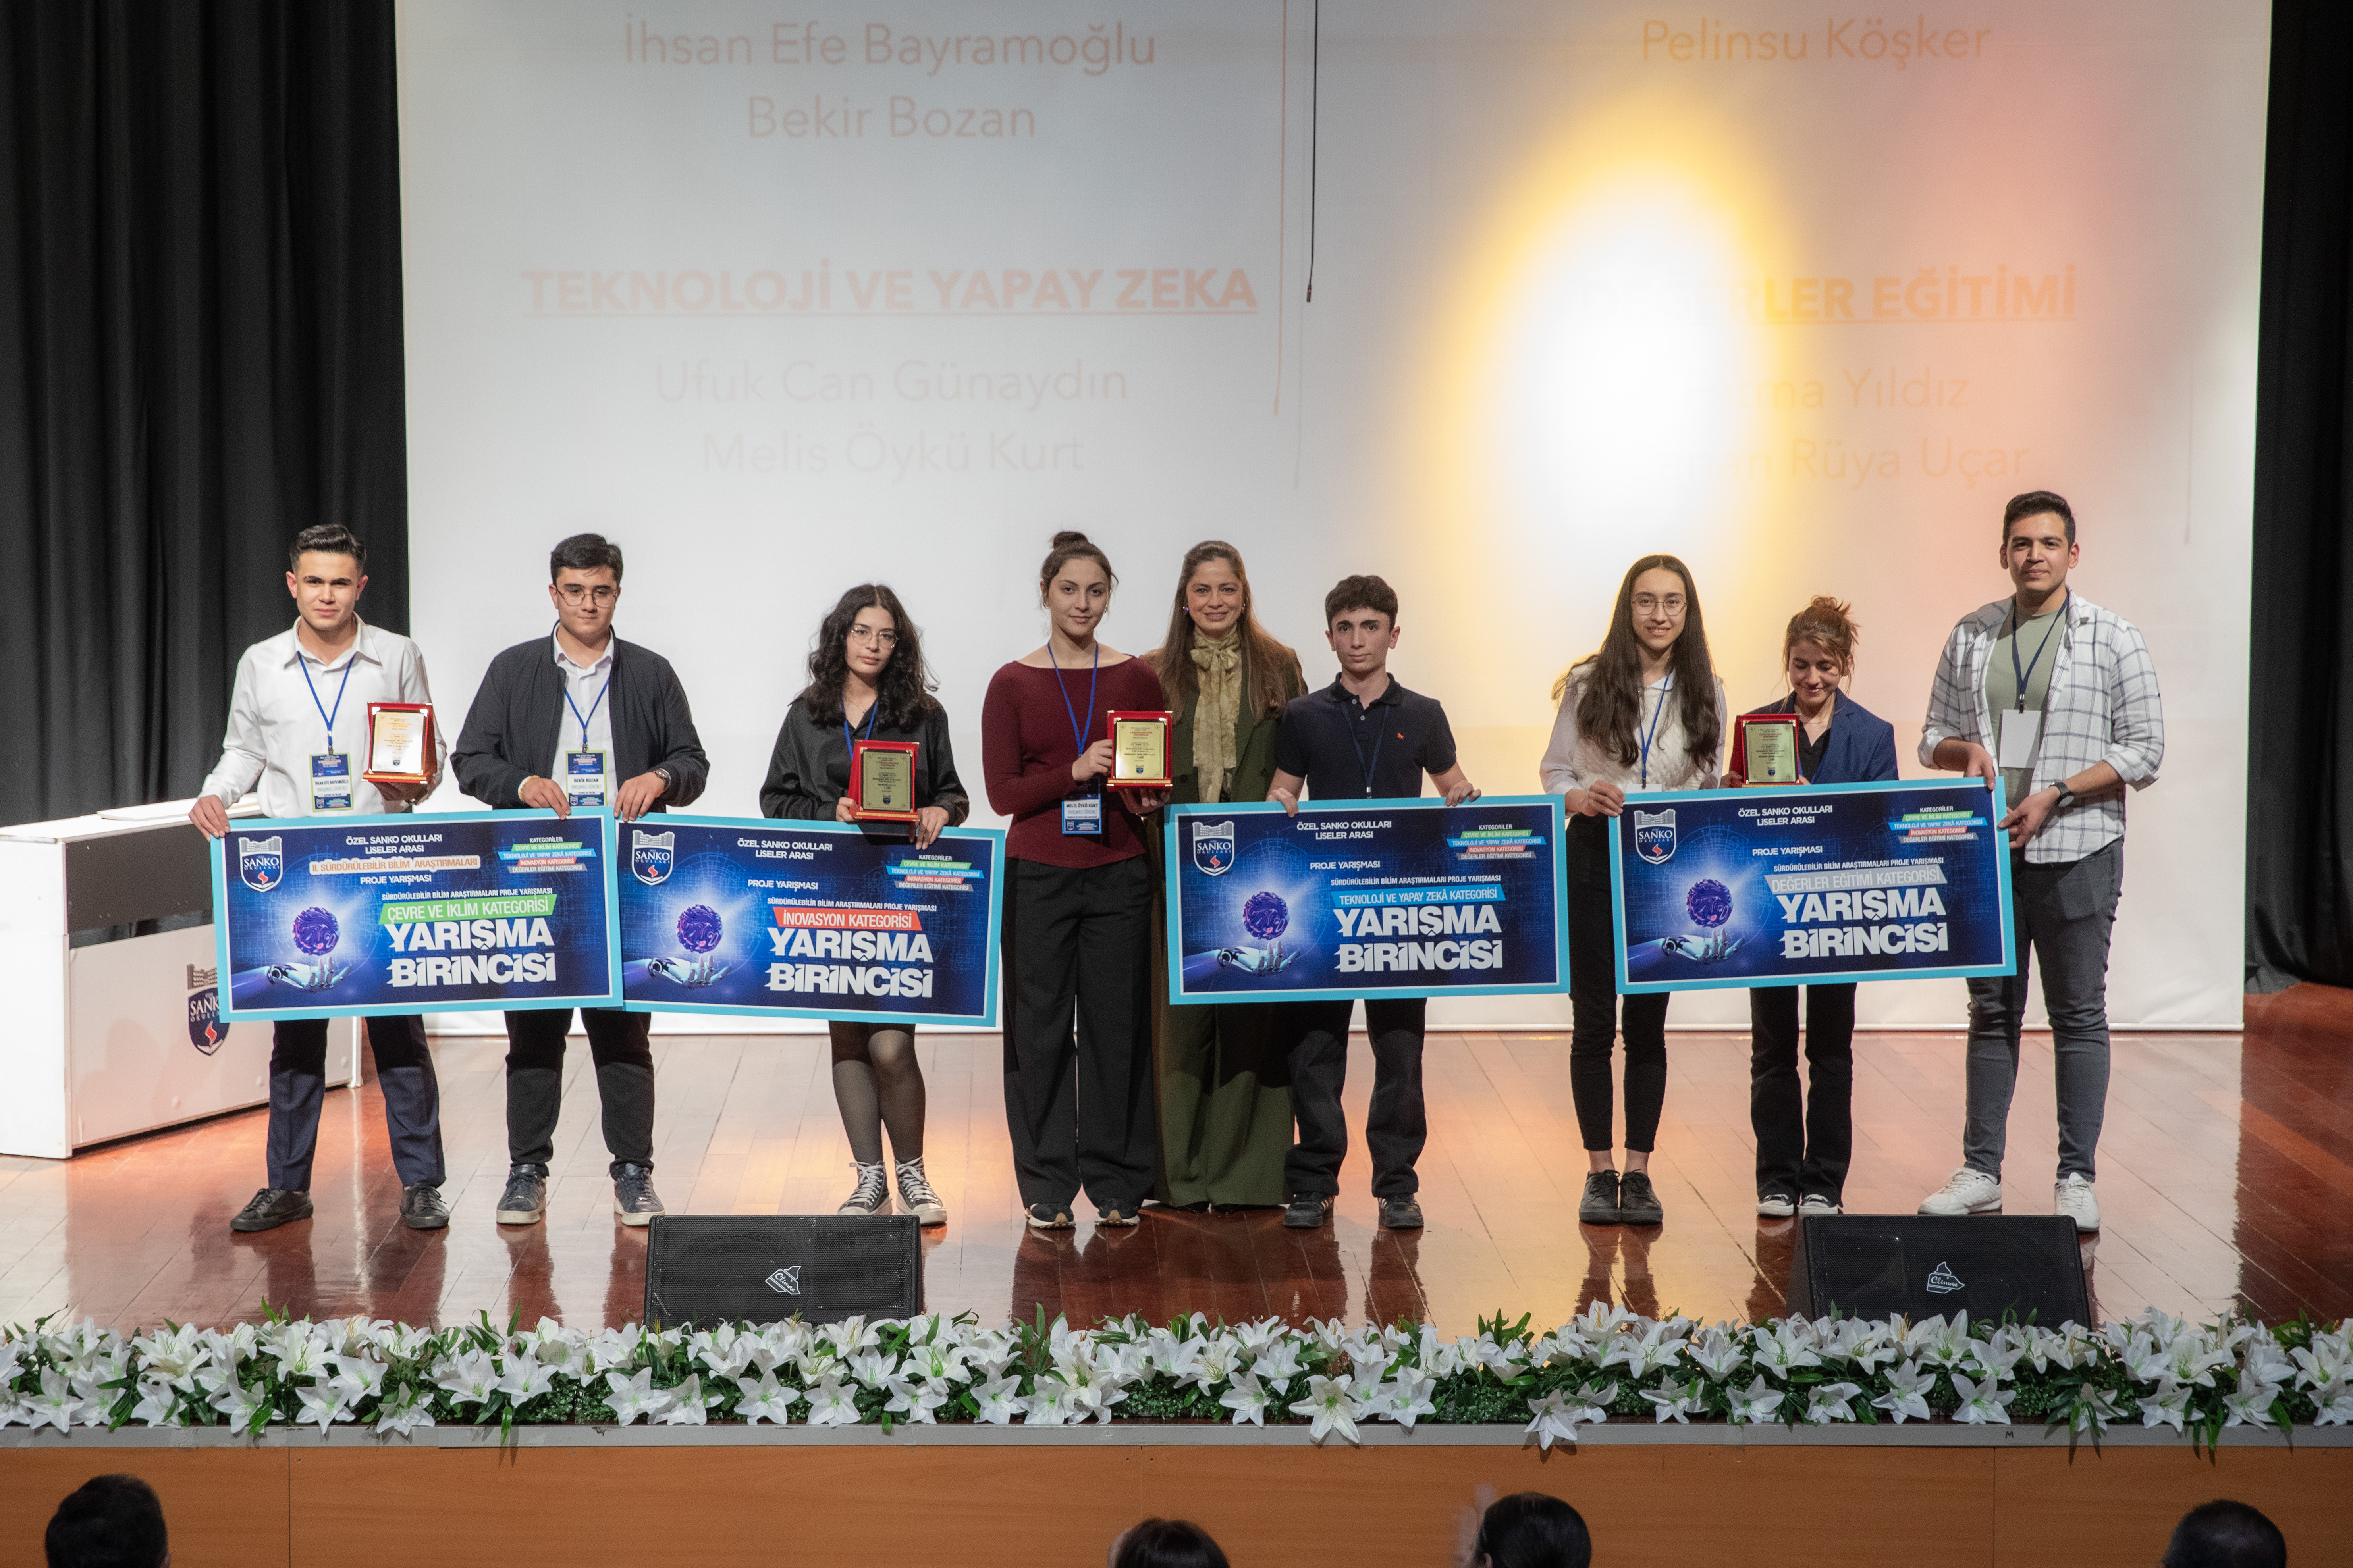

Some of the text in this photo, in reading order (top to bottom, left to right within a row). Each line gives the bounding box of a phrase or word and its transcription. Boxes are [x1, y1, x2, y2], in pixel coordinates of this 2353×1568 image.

[624, 13, 1156, 77] İhsan Efe Bayramoğlu
[1641, 15, 1992, 72] Pelinsu Köşker
[747, 95, 1036, 139] Bekir Bozan
[521, 258, 1258, 311] TEKNOLOJİ VE YAPAY ZEKA
[1873, 263, 2077, 318] EĞİTİMİ
[656, 358, 1129, 413] Ufuk Can Günaydın
[1843, 366, 1970, 409] Yıldız
[701, 421, 1086, 483] Melis Öykü Kurt
[1790, 437, 1903, 489] Rüya
[1921, 437, 2031, 489] Uçar
[1738, 805, 1833, 818] ÖZEL SANKO OKULLARI
[1296, 820, 1392, 831] ÖZEL SANKO OKULLARI
[1790, 815, 1815, 825] ARASI
[346, 834, 443, 846] ÖZEL SANKO OKULLARI
[1348, 830, 1374, 839] ARASI
[1639, 830, 1673, 840] SANKO
[399, 844, 424, 853] ARASI
[737, 837, 833, 851] ÖZEL SANKO OKULLARI
[1197, 842, 1231, 851] SANKO
[1752, 845, 1823, 857] PROJE YARIŞMASI
[243, 857, 279, 867] SANKO
[635, 851, 670, 861] SANKO
[789, 851, 814, 860] ARASI
[320, 860, 386, 872] SÜRDÜRÜLEBİLİR
[388, 859, 410, 869] BİLİM
[414, 858, 478, 870] ARAŞTIRMALARI
[1310, 860, 1381, 872] PROJE YARIŞMASI
[1773, 861, 1823, 873] SÜRDÜRÜLEBİLİR
[1823, 861, 1841, 870] BİLİM
[1841, 859, 1889, 870] ARAŞTIRMALARI
[1910, 857, 1944, 866] YARIŞMASI
[360, 874, 432, 886] PROJE YARIŞMASI
[748, 879, 818, 892] PROJE YARIŞMASI
[1330, 876, 1380, 886] SÜRDÜRÜLEBİLİR
[1381, 876, 1398, 885] BİLİM
[1398, 876, 1447, 886] ARAŞTIRMALARI
[1468, 875, 1501, 883] YARIŞMASI
[1771, 866, 1940, 892] DEĞERLER EĞİTİMİ KATEGORİSİ
[381, 890, 431, 901] SÜRDÜRÜLEBİLİR
[432, 890, 449, 899] BİLİM
[450, 889, 498, 899] ARAŞTIRMALARI
[519, 887, 552, 896] YARIŞMASI
[1339, 886, 1497, 905] TEKNOLOJİ VE YAPAY ZEKÂ KATEGORİSİ
[388, 896, 549, 924] ÇEVRE VE İKLİM KATEGORİSİ
[767, 896, 816, 907] SÜRDÜRÜLEBİLİR
[817, 899, 834, 907] BİLİM
[835, 900, 883, 909] ARAŞTIRMALARI
[903, 903, 937, 913] YARIŞMASI
[1776, 887, 1947, 923] YARIŞMA
[783, 909, 911, 928] İNOVASYON KATEGORİSİ
[1332, 904, 1502, 937] YARIŞMA
[384, 917, 555, 952] YARIŞMA
[767, 927, 933, 963] YARIŞMA
[190, 996, 220, 1016] SANK
[775, 1273, 795, 1292] Climax
[1931, 1276, 1958, 1287] Climax
[2005, 1430, 2014, 1439] M
